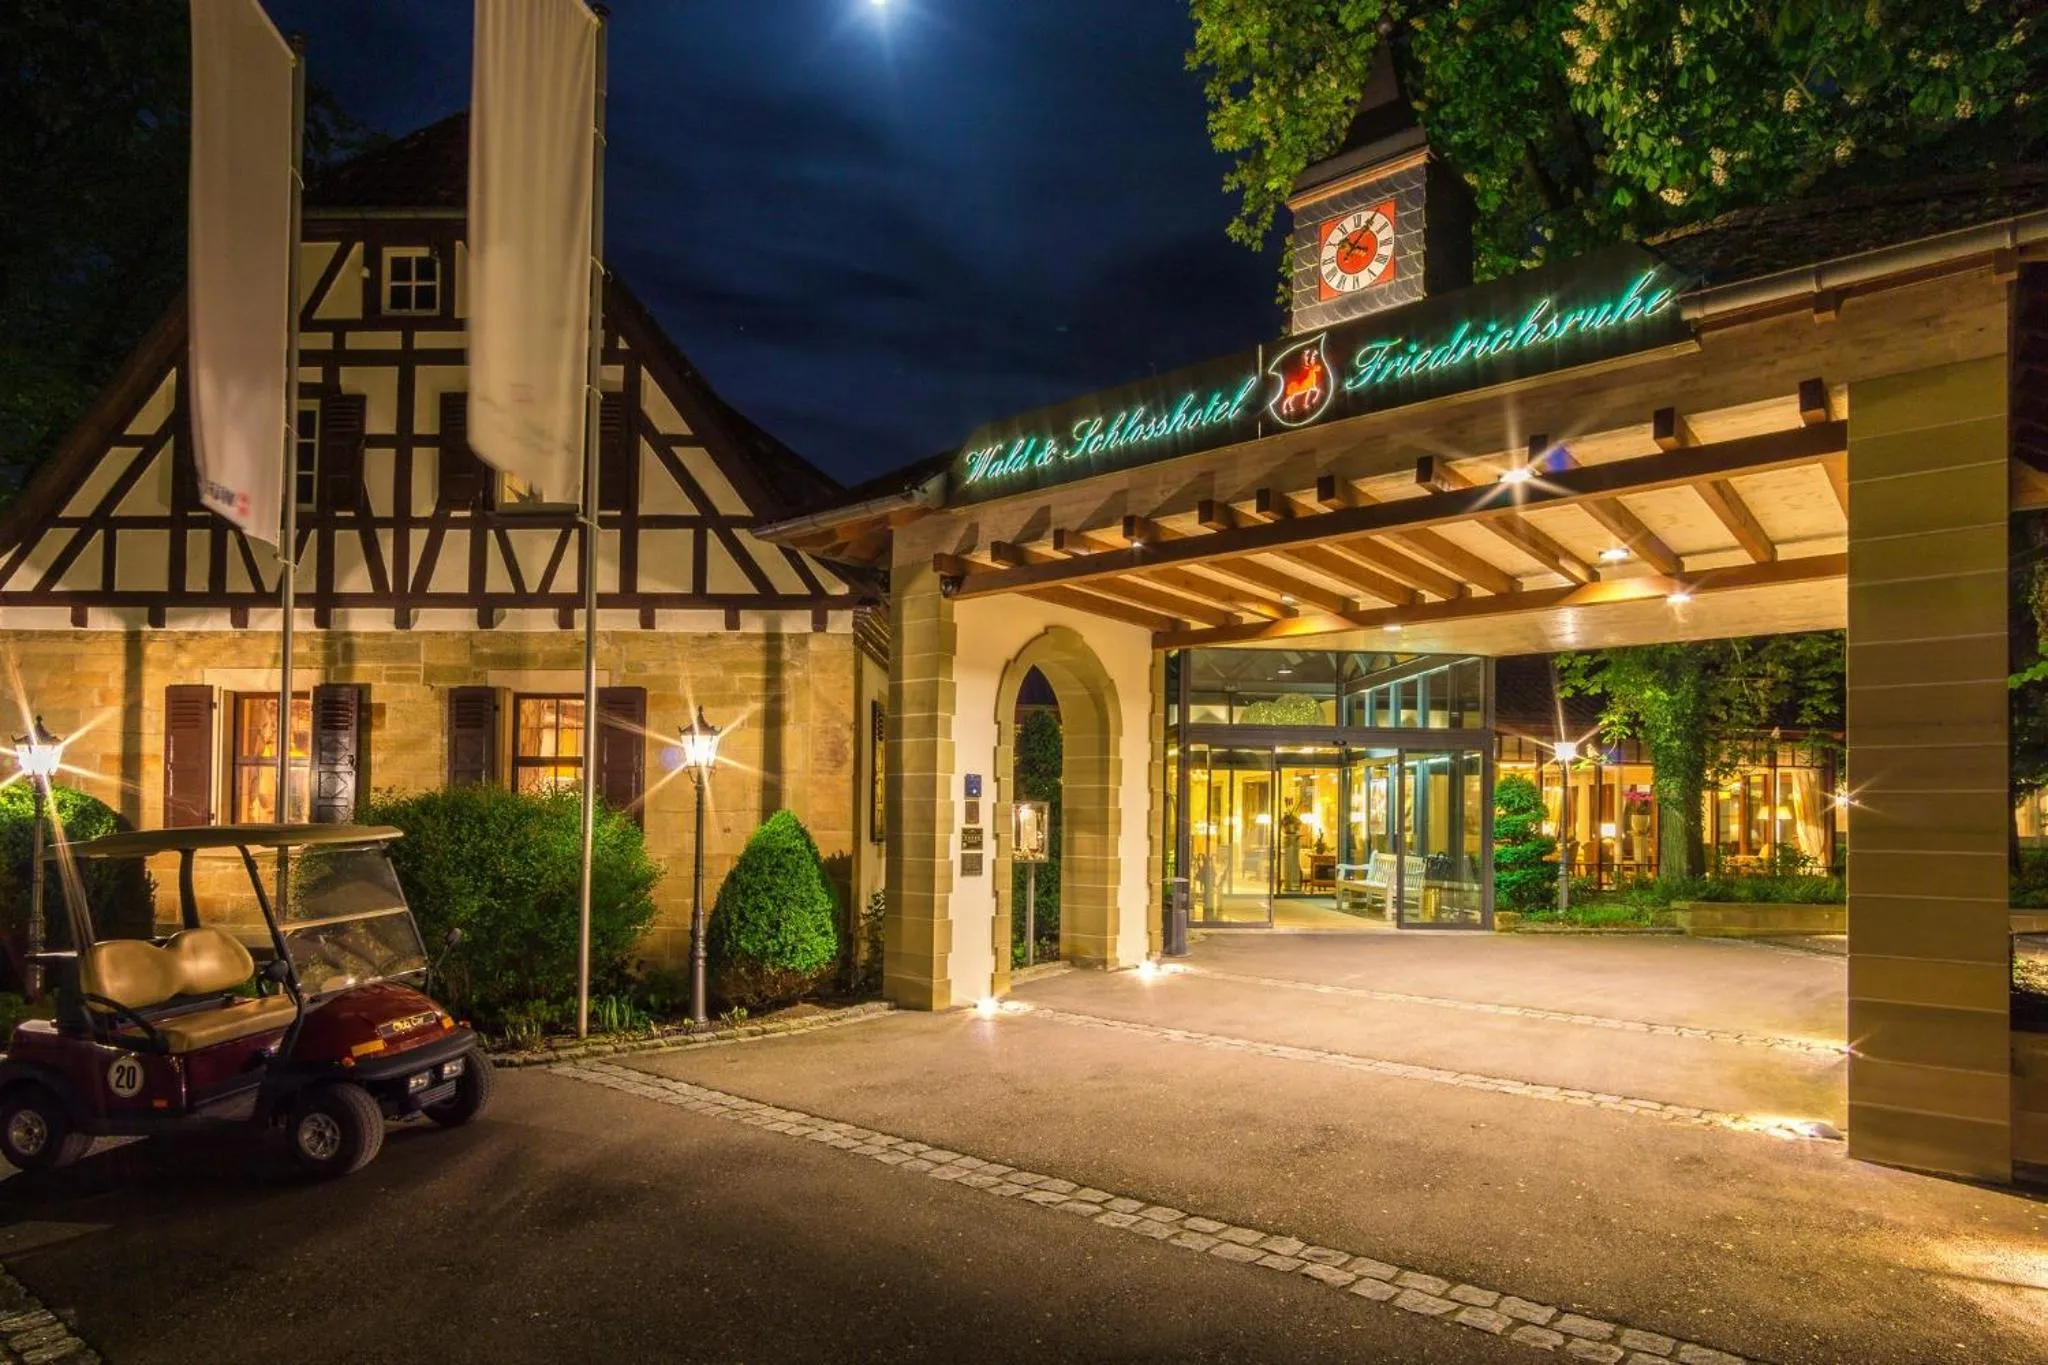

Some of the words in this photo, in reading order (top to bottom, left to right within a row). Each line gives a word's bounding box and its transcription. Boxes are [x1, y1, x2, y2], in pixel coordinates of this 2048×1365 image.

[966, 437, 1036, 485] Wald
[1035, 439, 1057, 467] &
[1063, 376, 1257, 460] Schlosshotel
[1345, 270, 1673, 389] Friedrichsruhe
[115, 1064, 136, 1090] 20
